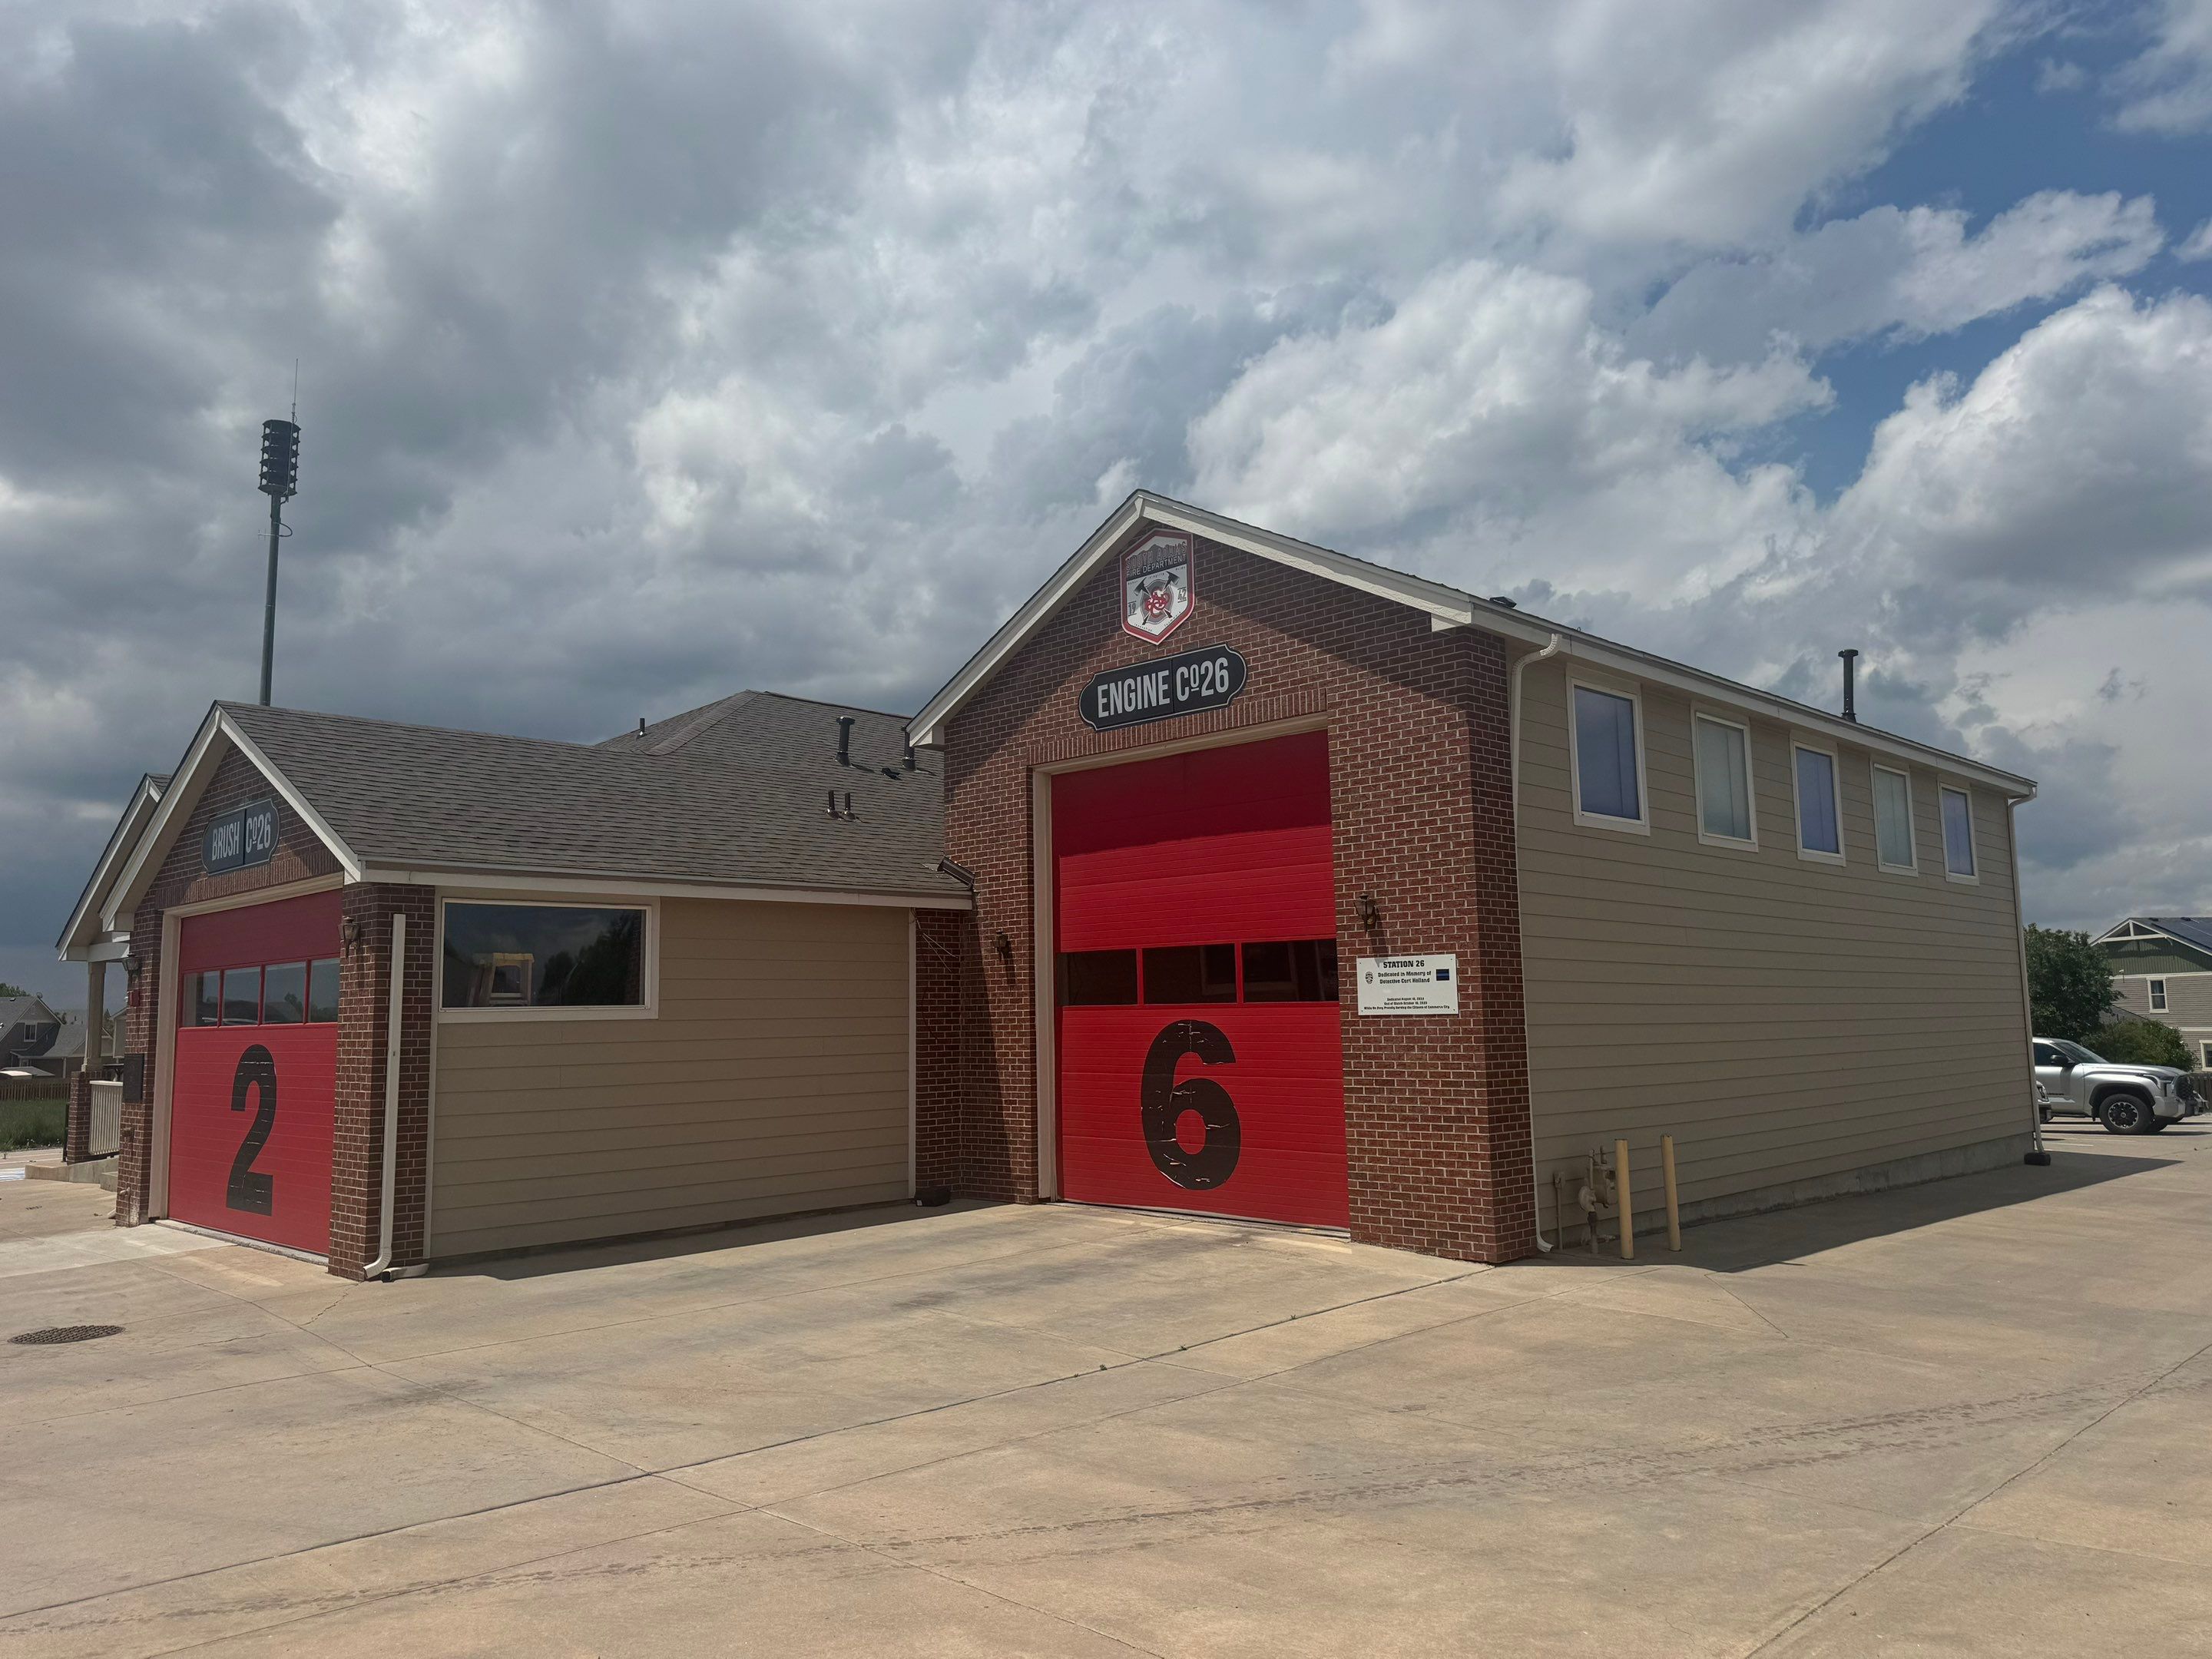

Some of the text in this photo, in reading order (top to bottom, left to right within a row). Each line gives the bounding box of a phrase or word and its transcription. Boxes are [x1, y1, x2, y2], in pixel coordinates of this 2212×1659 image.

[1126, 568, 1141, 578] FIRE
[1142, 554, 1186, 573] DEPARTMENT
[1128, 603, 1136, 615] 19
[1097, 670, 1170, 718] ENGINE
[212, 821, 240, 861] BRUSH
[1141, 1019, 1241, 1190] 6
[226, 1044, 276, 1216] 2
